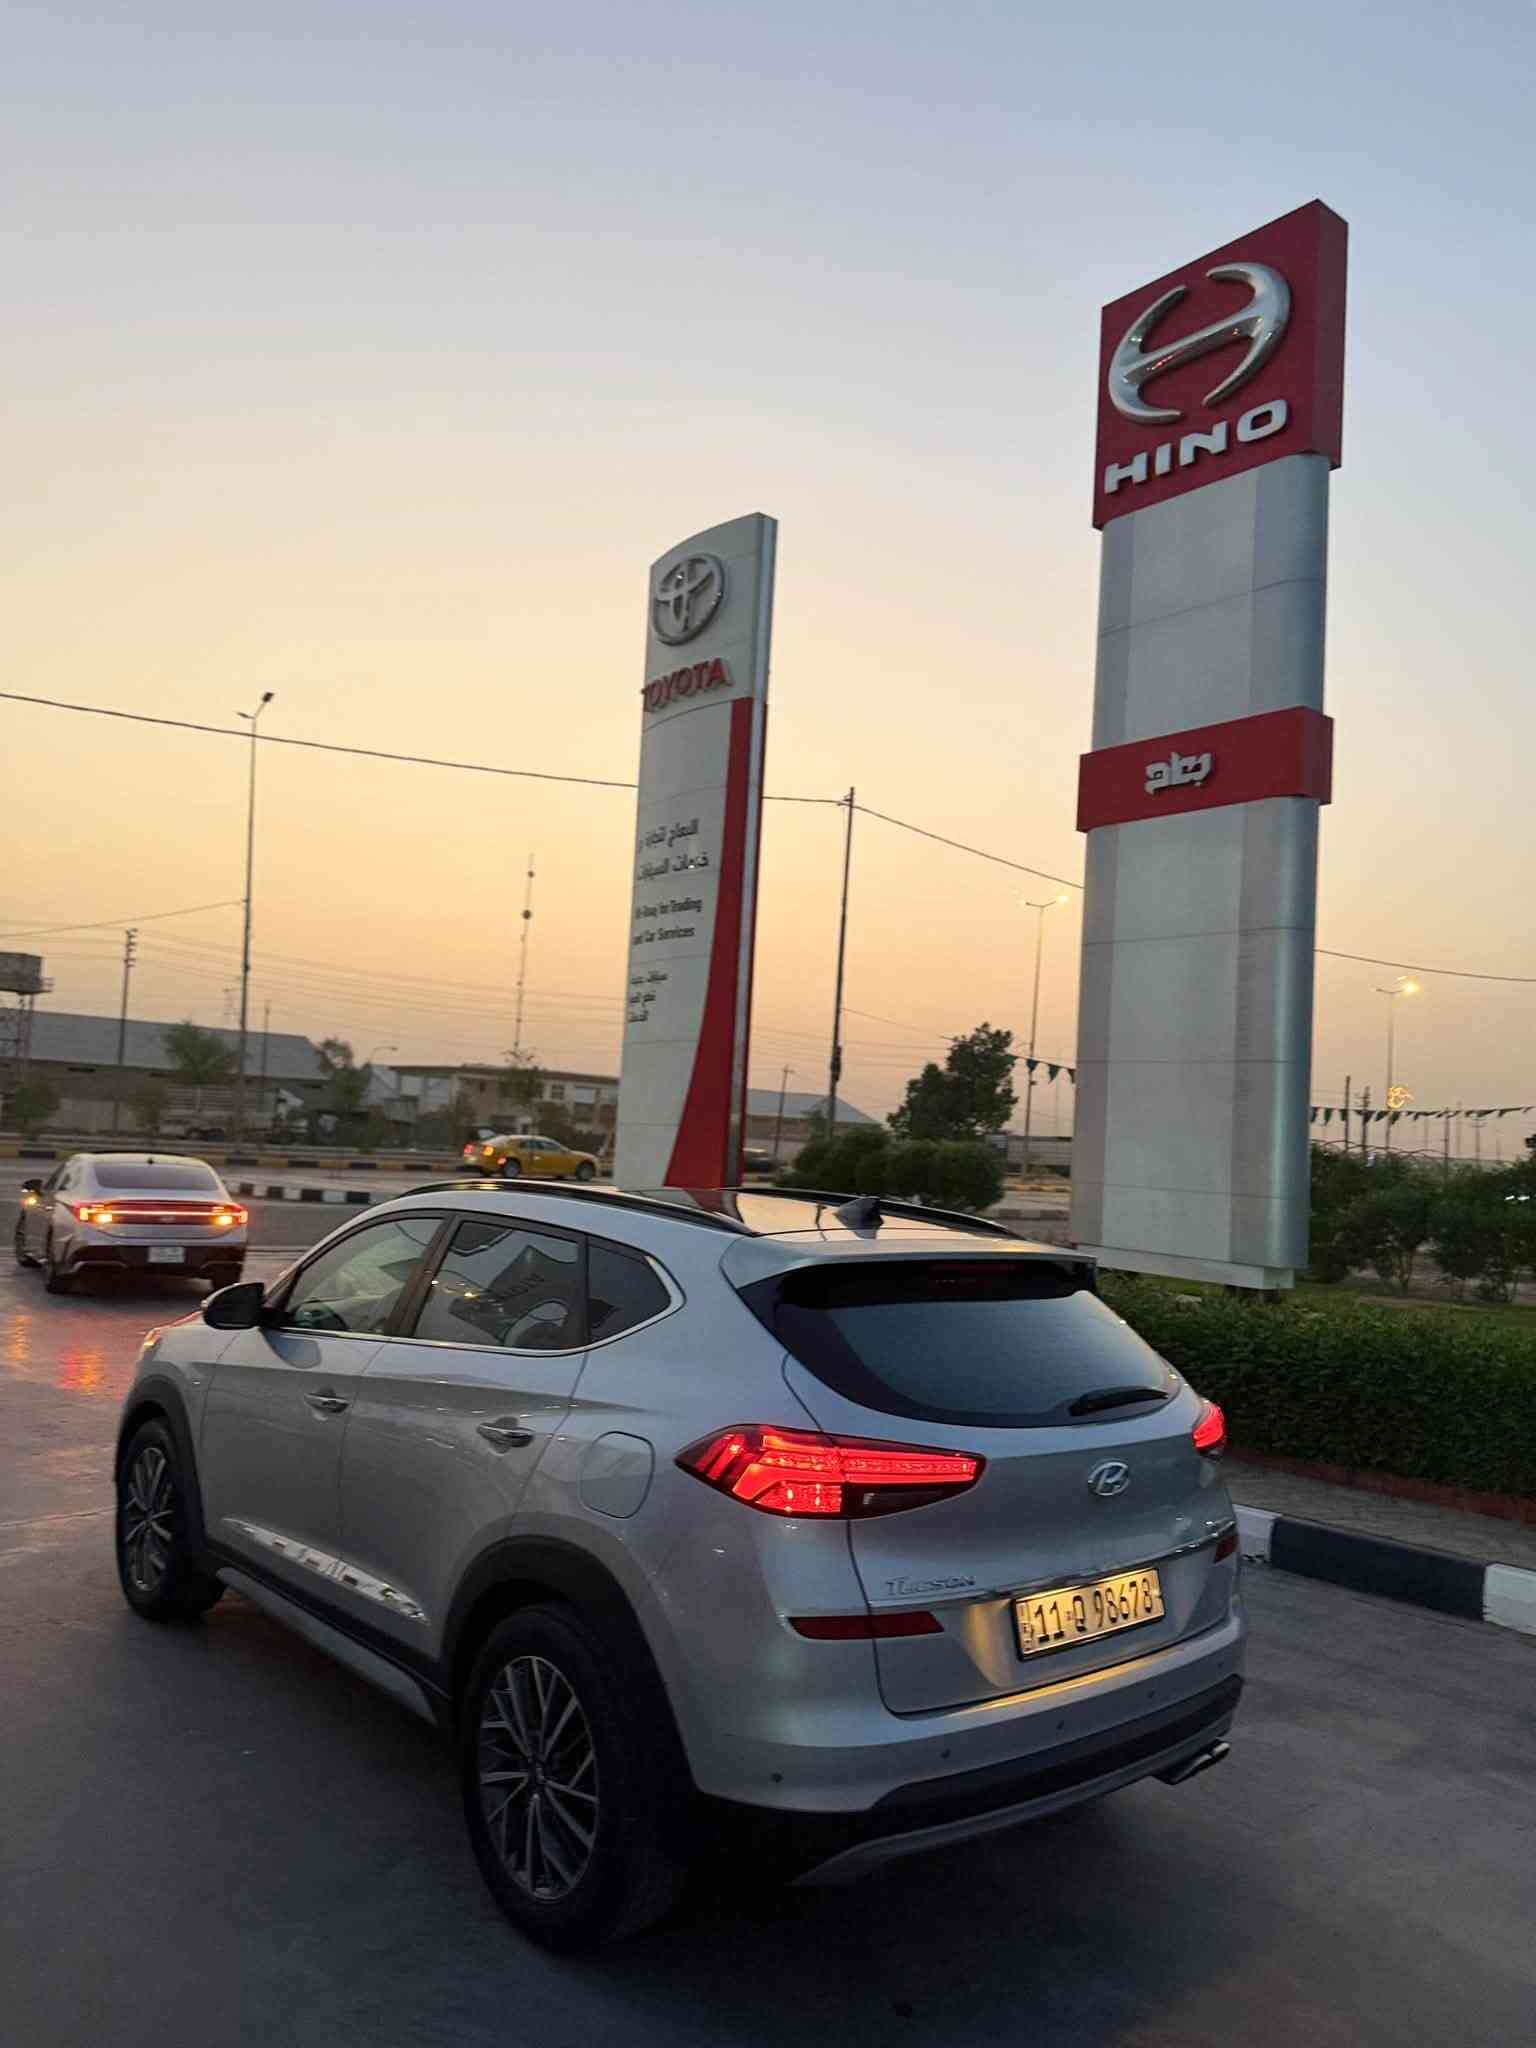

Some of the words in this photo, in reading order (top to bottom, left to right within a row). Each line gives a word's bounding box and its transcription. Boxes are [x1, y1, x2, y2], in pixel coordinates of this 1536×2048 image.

[1104, 400, 1288, 495] HINO
[641, 657, 733, 712] TOYOTA
[1034, 1600, 1065, 1644] 11
[1094, 1577, 1153, 1628] 98678
